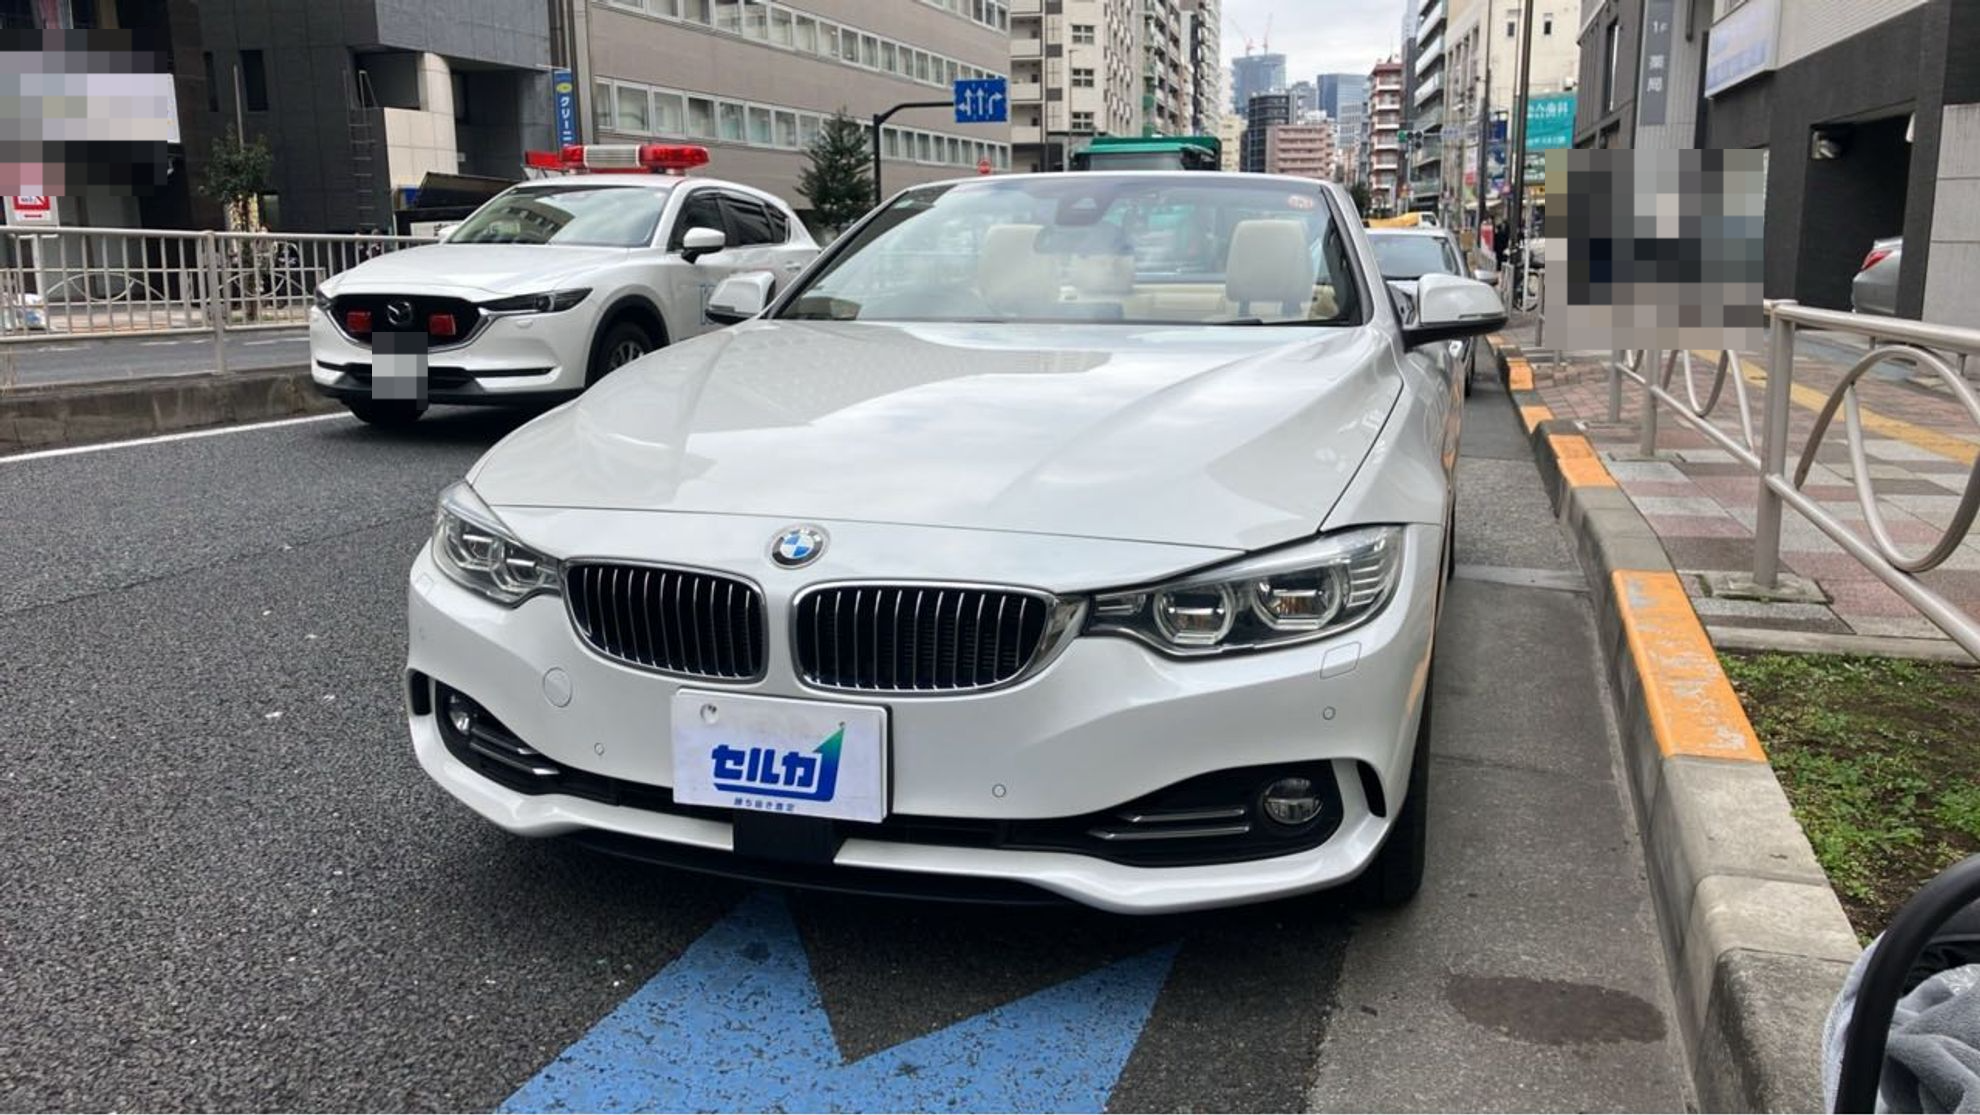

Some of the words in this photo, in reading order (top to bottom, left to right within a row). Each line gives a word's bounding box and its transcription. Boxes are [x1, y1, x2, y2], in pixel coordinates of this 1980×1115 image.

[560, 96, 573, 147] クリーニ
[711, 744, 817, 788] セルカ
